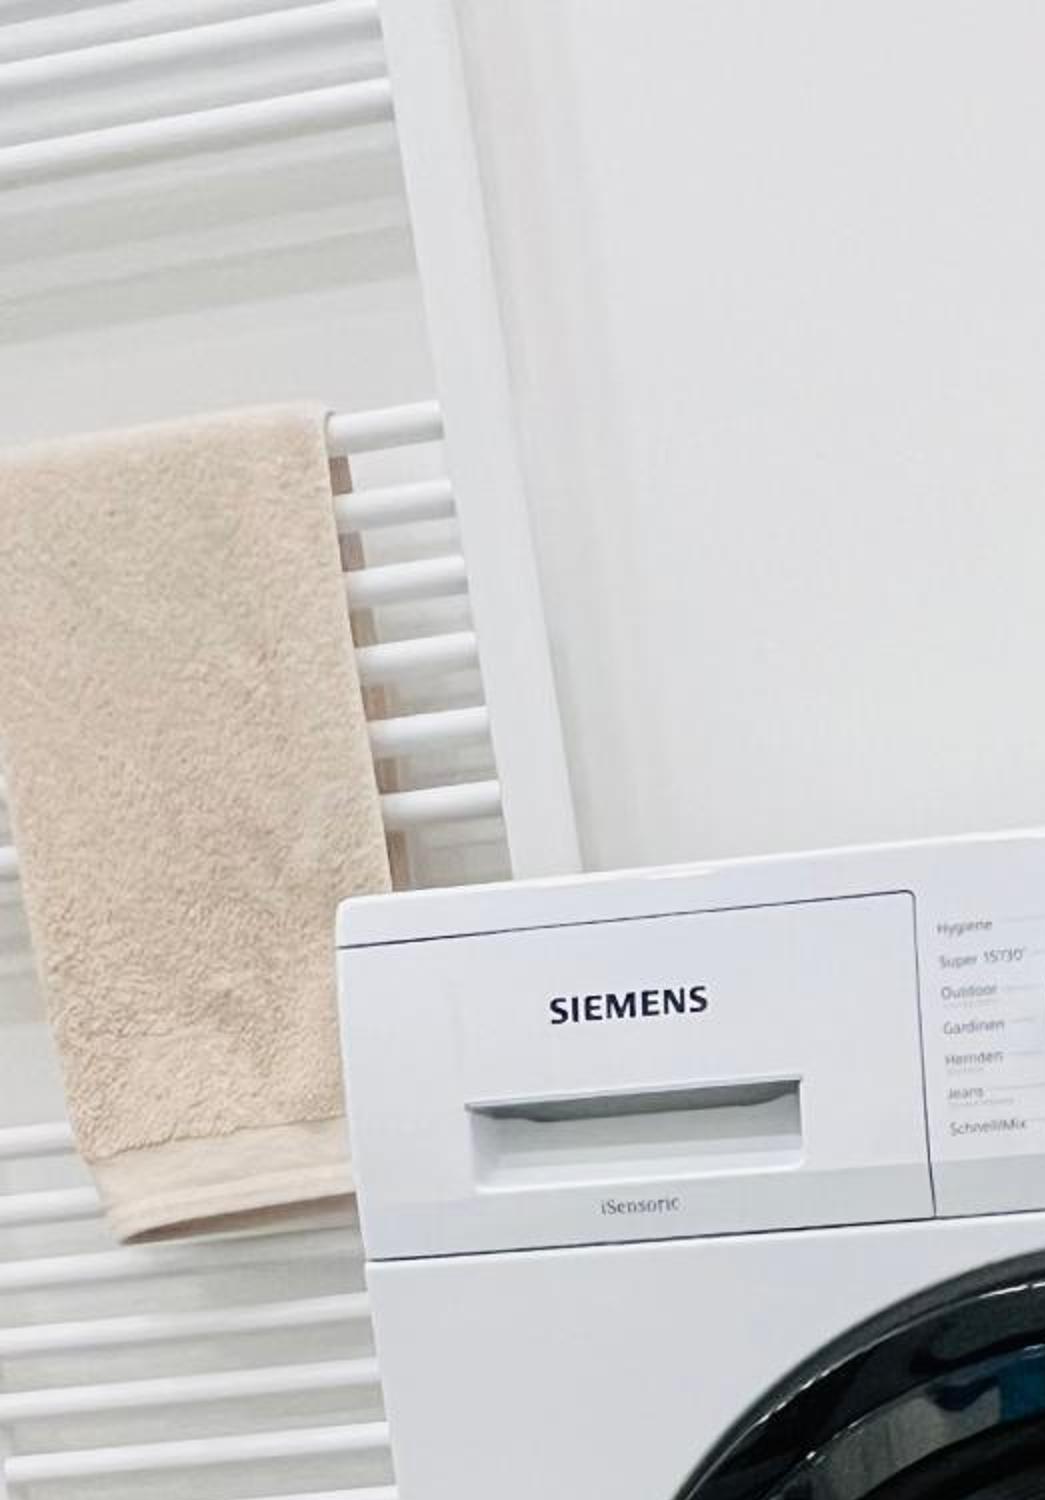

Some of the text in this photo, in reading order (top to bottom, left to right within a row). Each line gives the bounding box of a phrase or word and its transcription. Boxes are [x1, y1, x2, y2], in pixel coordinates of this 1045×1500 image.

[937, 920, 993, 937] Hygiene
[938, 952, 977, 970] Super
[941, 983, 997, 1000] Outdoor
[549, 985, 708, 1024] SIEMENS
[943, 1018, 1005, 1036] Gardinen
[945, 1050, 1003, 1066] Hemden
[948, 1086, 984, 1099] Jeans
[949, 1117, 1027, 1136] Schnell/Mix
[600, 1194, 680, 1215] iSensoric
